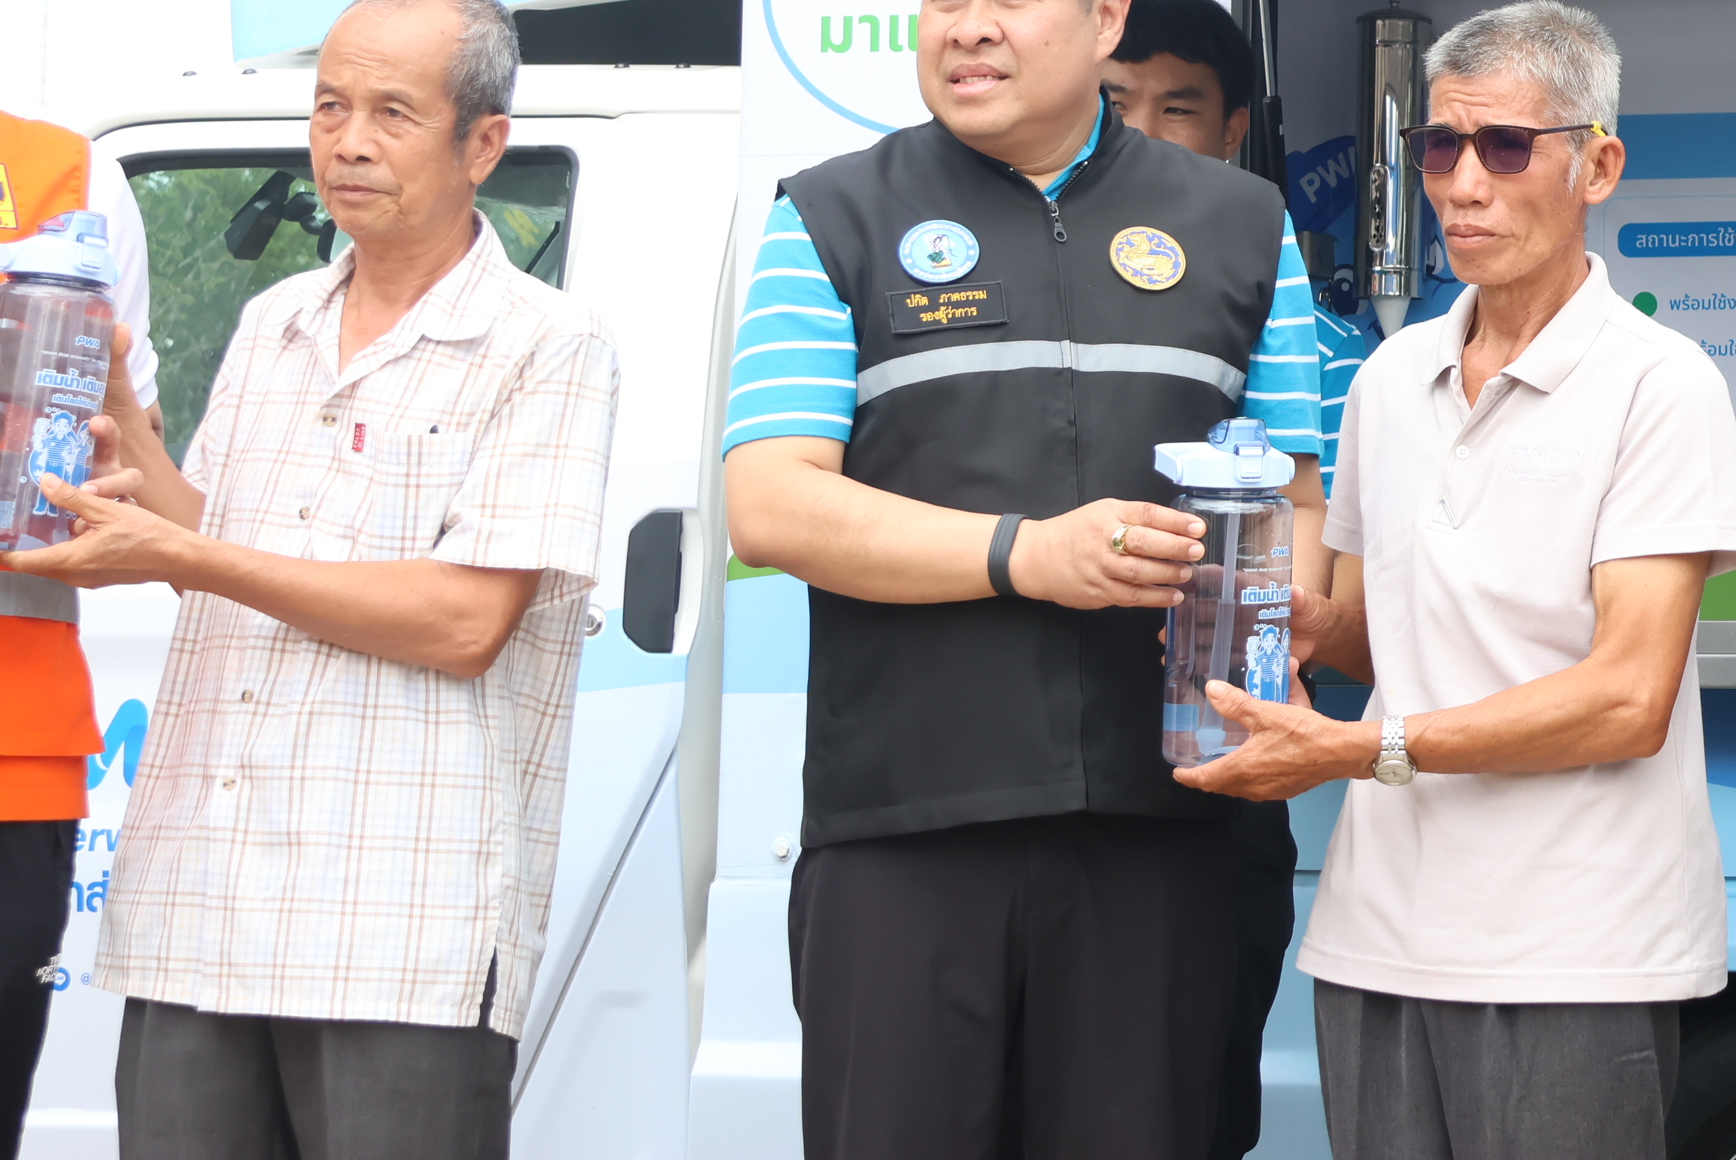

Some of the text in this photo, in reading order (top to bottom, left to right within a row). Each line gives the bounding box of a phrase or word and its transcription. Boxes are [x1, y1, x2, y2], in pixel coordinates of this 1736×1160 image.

[919, 306, 978, 324] รองผู้ว่าการ
